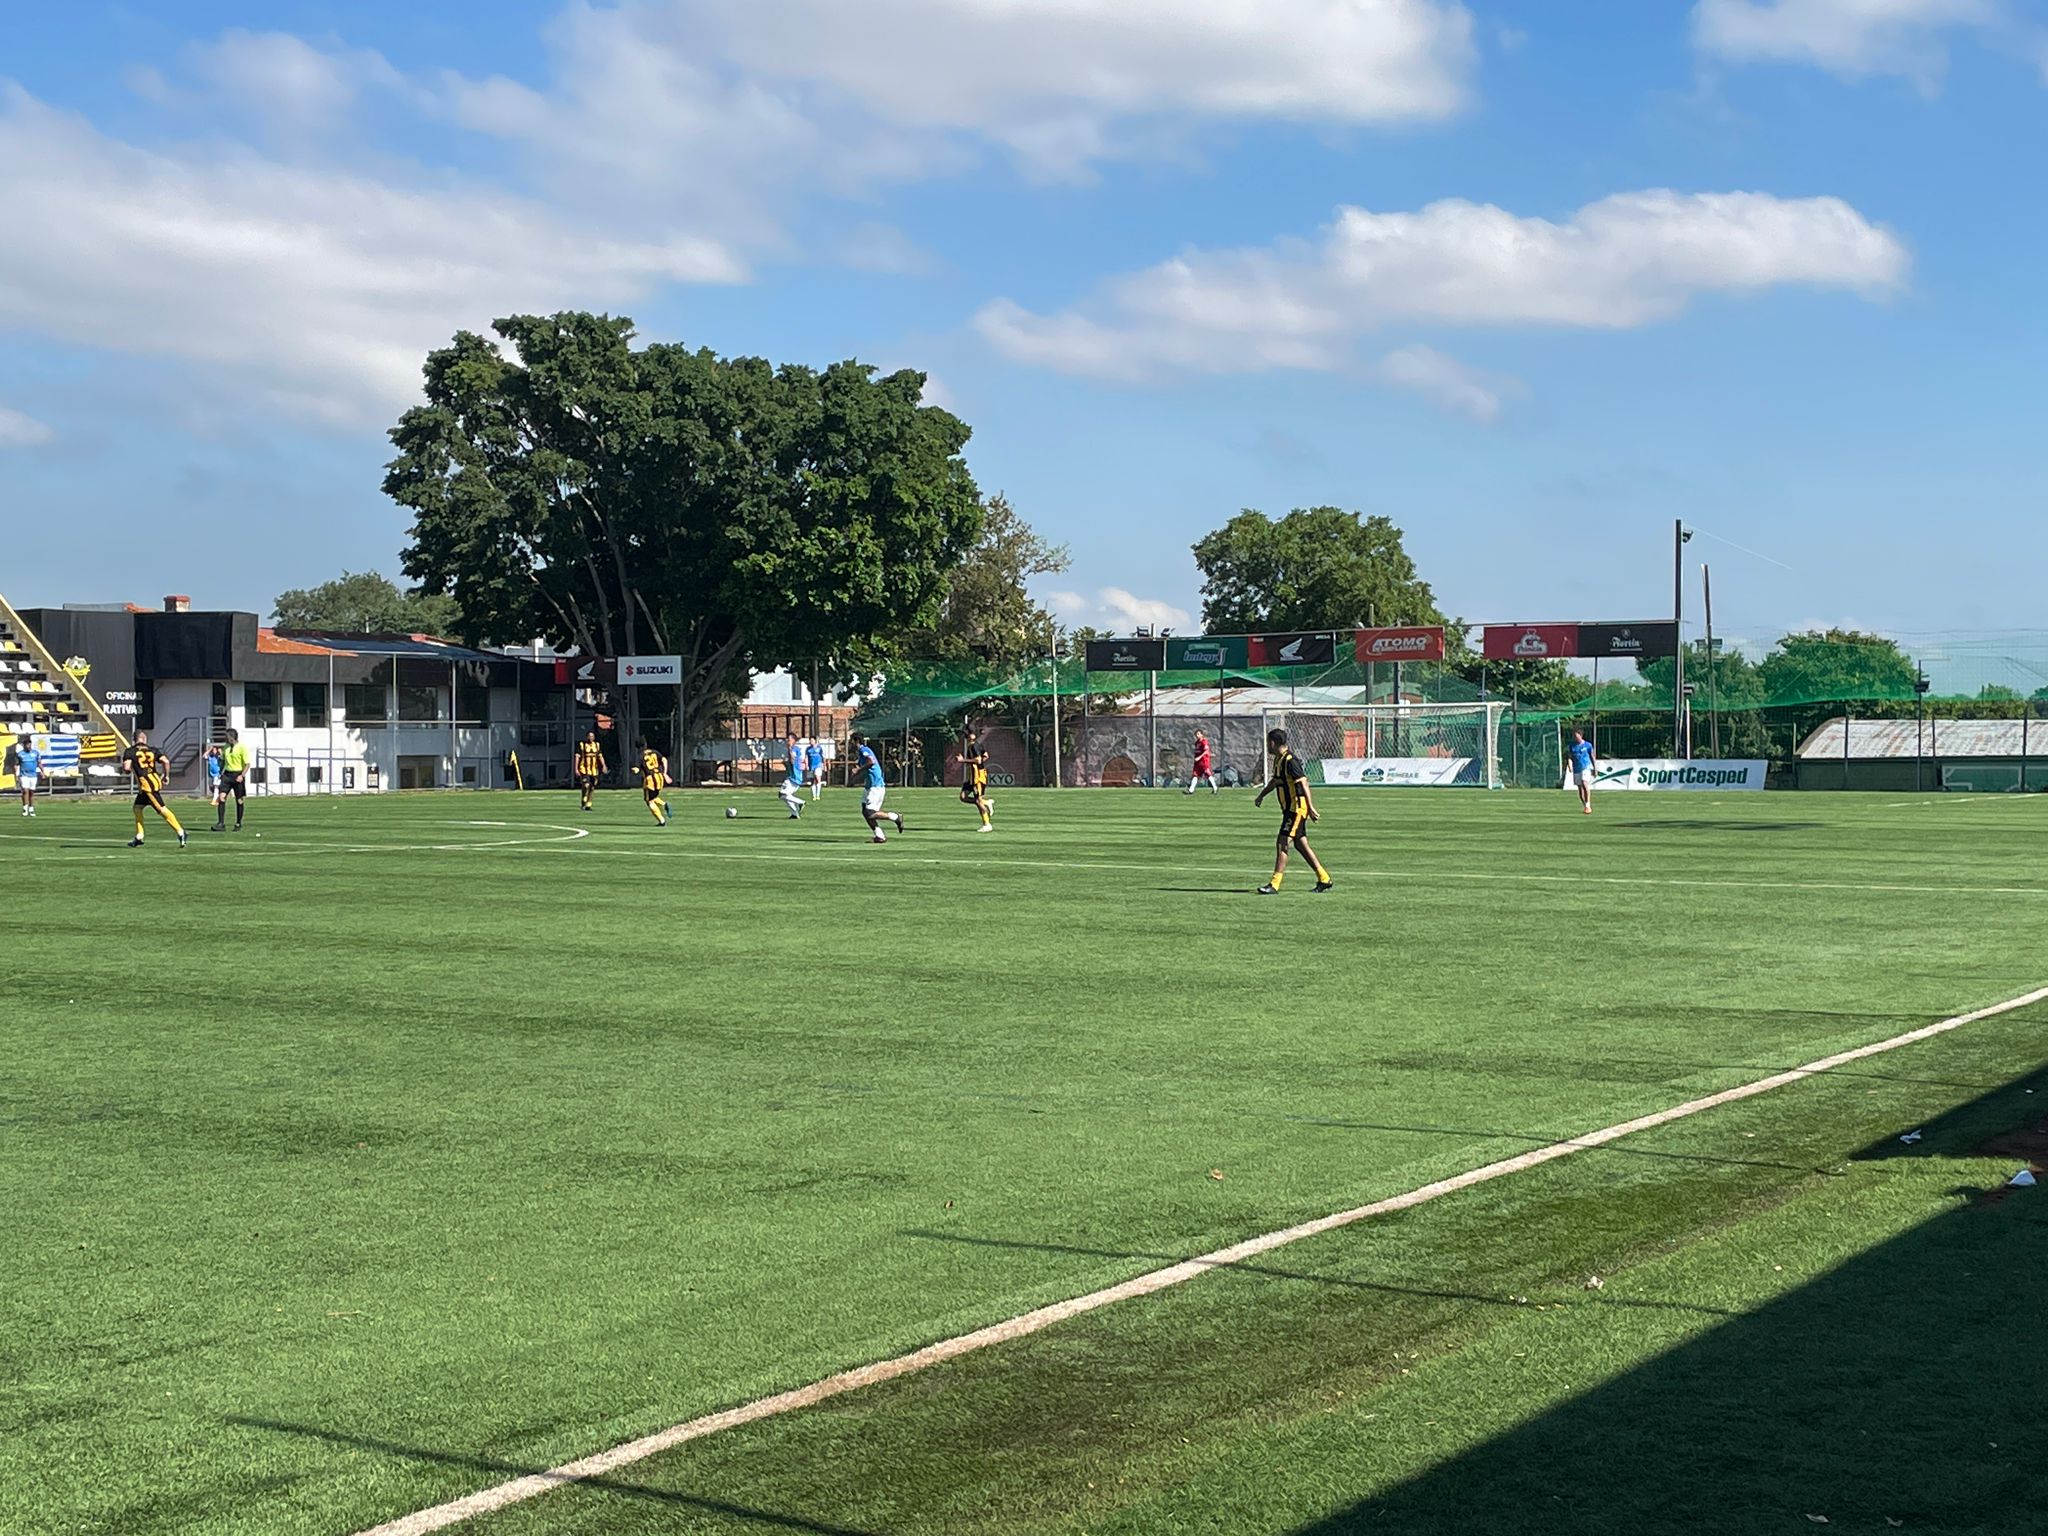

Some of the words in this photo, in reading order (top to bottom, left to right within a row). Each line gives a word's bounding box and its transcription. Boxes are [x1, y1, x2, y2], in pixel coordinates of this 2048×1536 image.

[1374, 637, 1427, 647] ATOMO
[636, 666, 673, 674] SUZUKI
[1637, 767, 1748, 787] SportCesped
